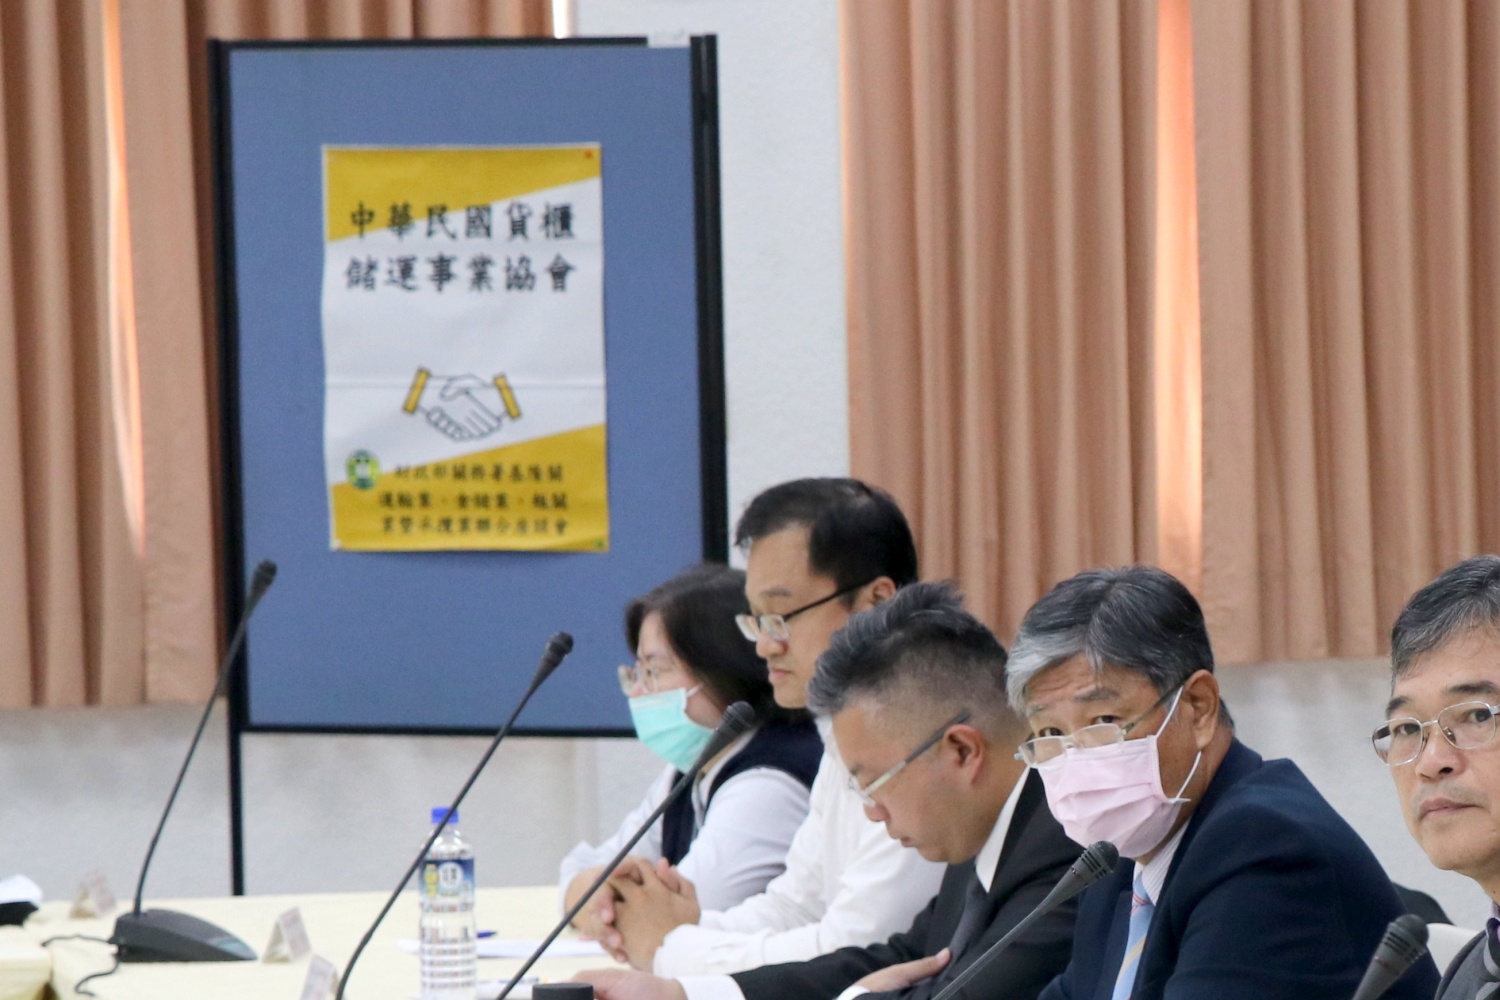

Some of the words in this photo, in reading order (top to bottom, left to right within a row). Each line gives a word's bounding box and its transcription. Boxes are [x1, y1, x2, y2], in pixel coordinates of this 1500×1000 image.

[349, 201, 576, 241] 中華民國貨櫃
[345, 252, 577, 293] 儲運事業協會
